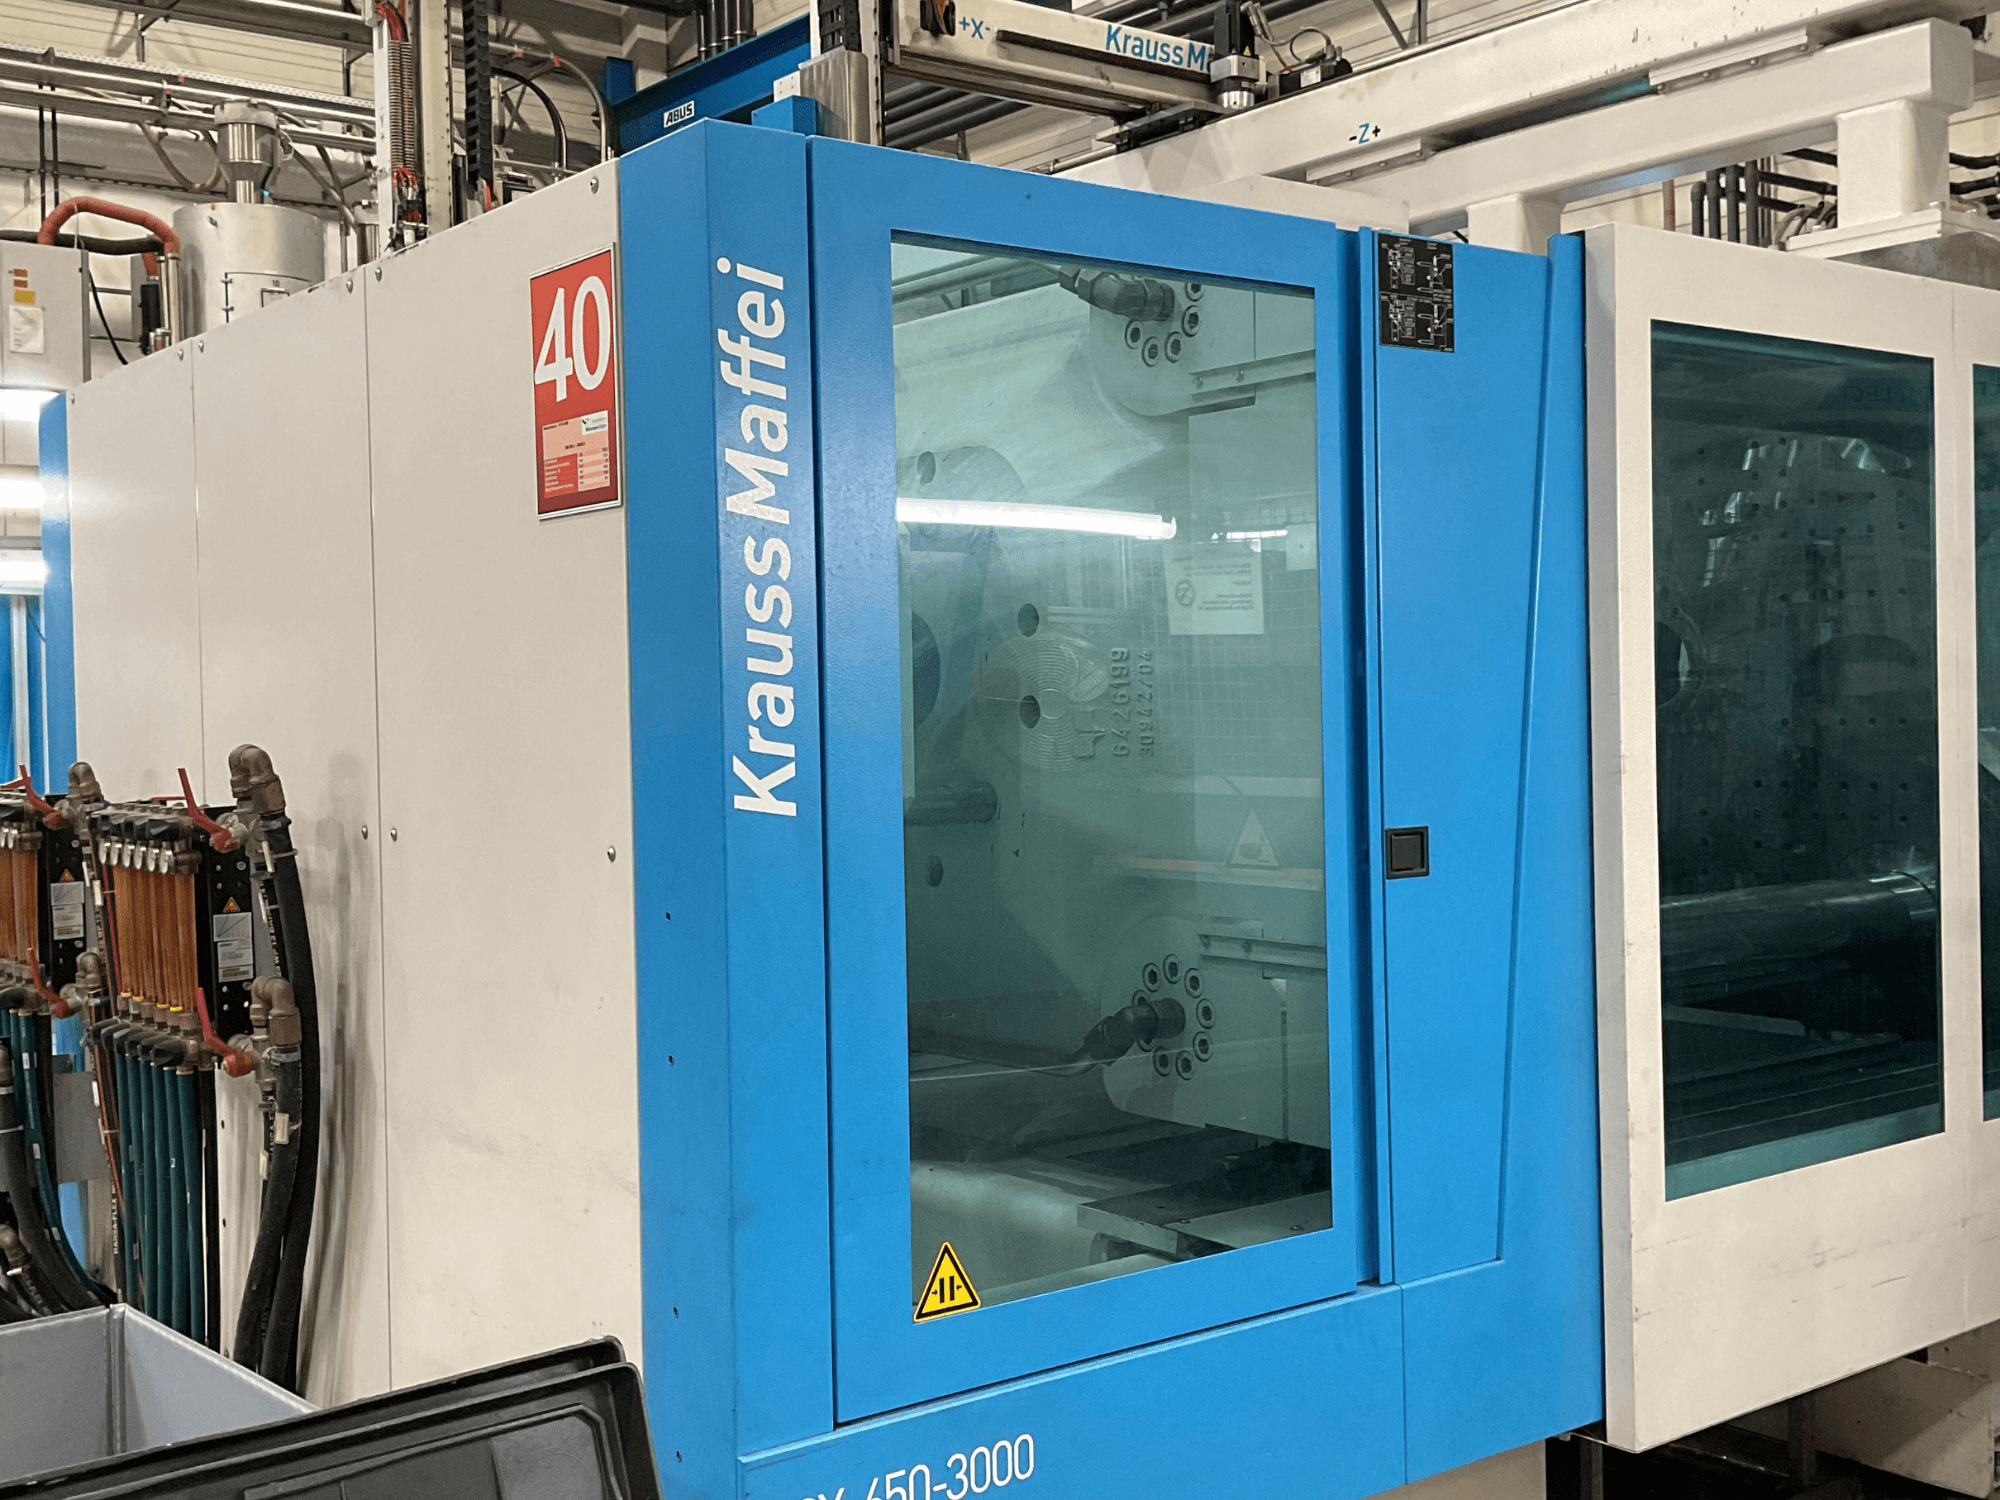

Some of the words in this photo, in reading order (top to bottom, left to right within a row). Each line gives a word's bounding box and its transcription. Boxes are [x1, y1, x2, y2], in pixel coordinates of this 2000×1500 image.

[666, 103, 692, 125] ABUS
[534, 275, 611, 402] 40
[717, 257, 796, 817] KraussMaffei
